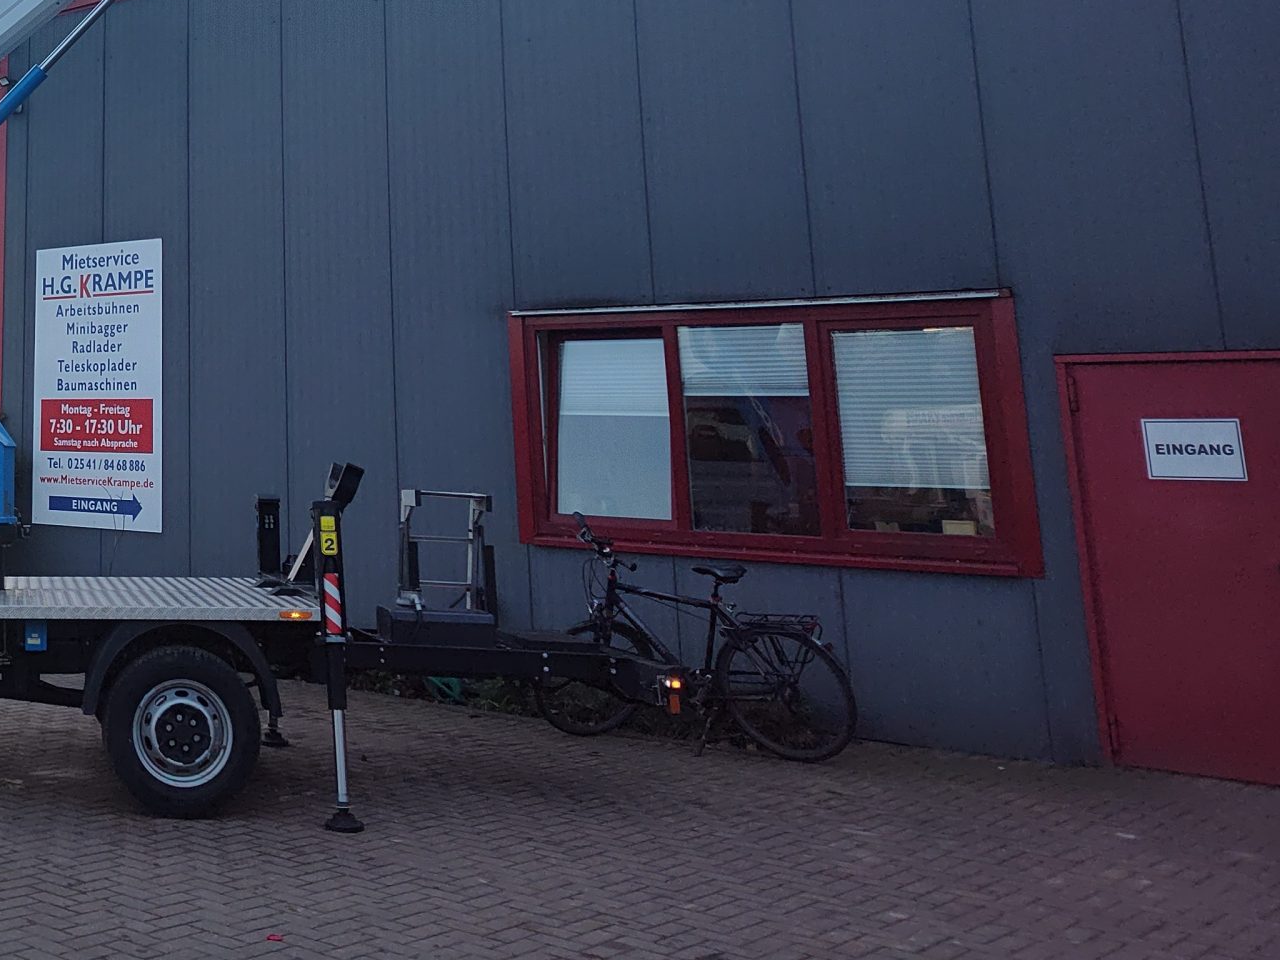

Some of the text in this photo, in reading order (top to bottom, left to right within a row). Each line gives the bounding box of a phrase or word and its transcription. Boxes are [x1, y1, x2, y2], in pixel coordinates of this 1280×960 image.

[62, 249, 140, 271] Mietservice
[55, 301, 140, 318] Arbeitsbühnen
[66, 321, 129, 338] Minibagger
[72, 340, 122, 354] Radlader
[57, 358, 138, 376] Teleskoplader
[57, 378, 137, 392] Baumaschinen
[61, 403, 92, 418] Montag
[99, 403, 131, 418] Freitag
[49, 418, 73, 434] 7:30
[84, 419, 115, 435] 17:30
[117, 419, 143, 435] Uhr
[53, 437, 138, 450] Samstag nach Absprache
[1154, 443, 1234, 456] EINGANG
[39, 474, 154, 490] www.MietserviceKrampe.de
[71, 500, 118, 512] EINGANG
[324, 537, 335, 551] 2
